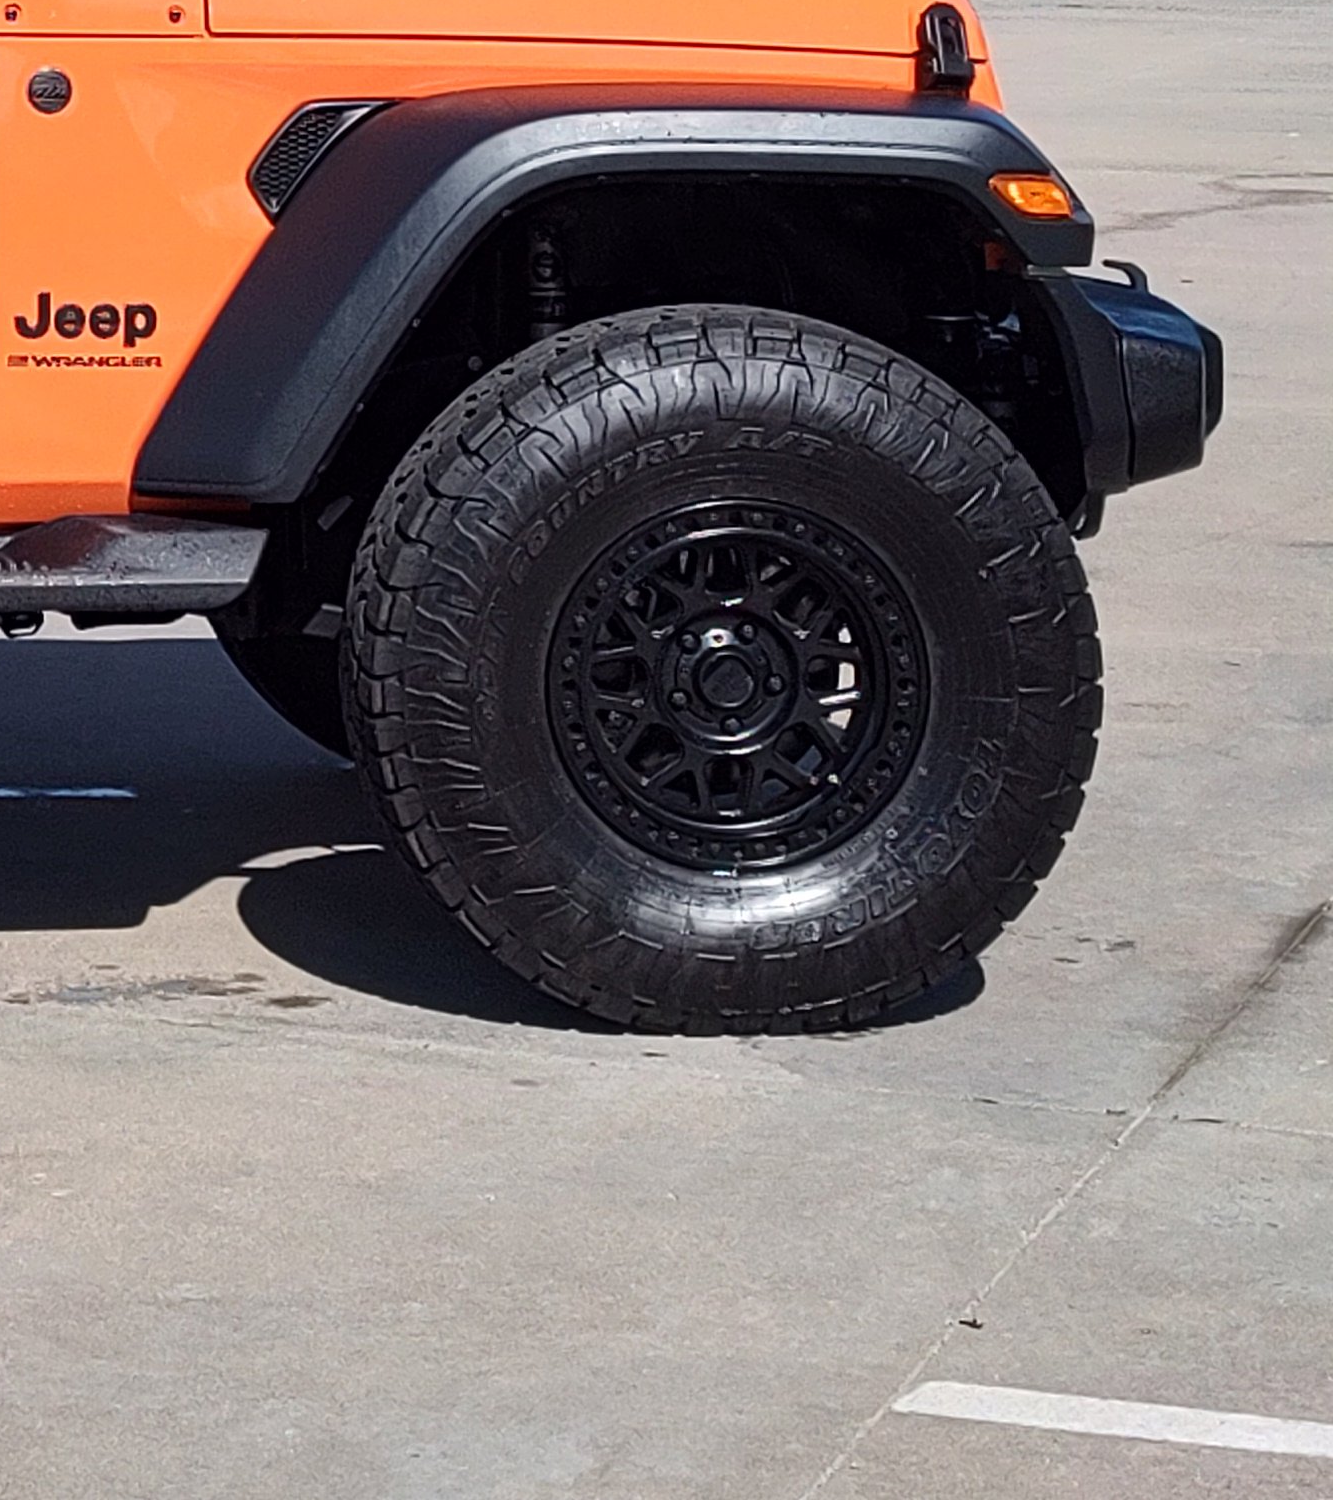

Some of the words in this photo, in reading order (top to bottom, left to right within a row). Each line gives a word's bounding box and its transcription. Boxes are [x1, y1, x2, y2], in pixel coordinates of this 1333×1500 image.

[14, 292, 157, 348] Jeep
[31, 355, 162, 368] WRANGLER
[507, 428, 706, 584] COUNTRY
[725, 423, 834, 459] A/T
